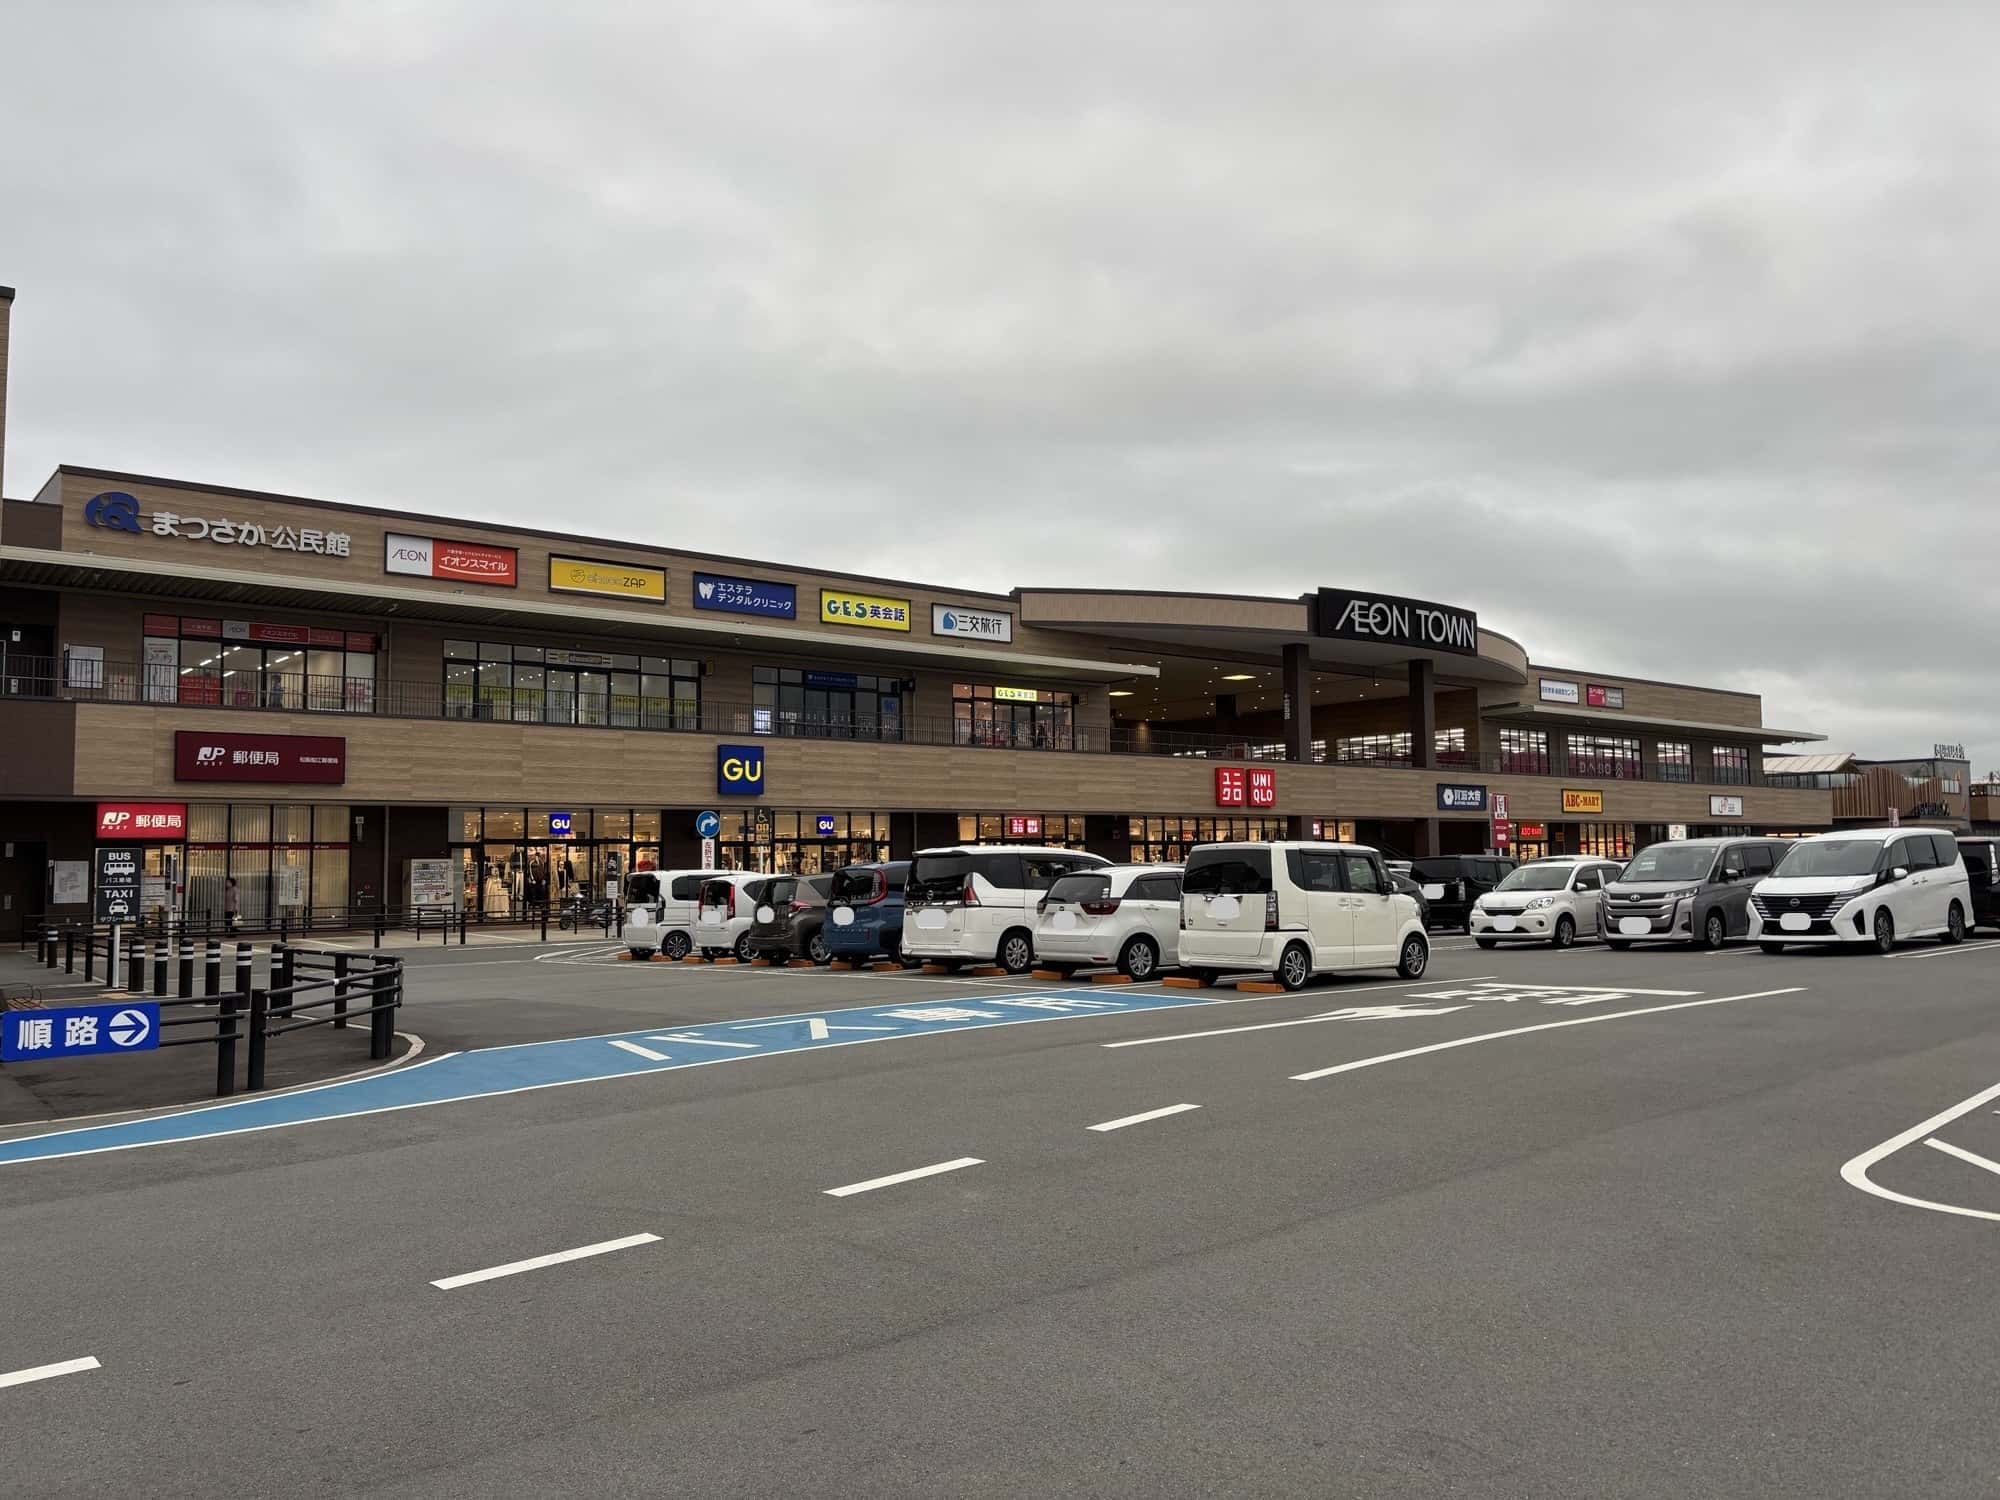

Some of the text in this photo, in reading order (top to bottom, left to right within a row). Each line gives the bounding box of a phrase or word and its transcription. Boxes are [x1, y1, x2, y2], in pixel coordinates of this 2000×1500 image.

[152, 511, 351, 558] まつさか公民館
[441, 556, 507, 571] イオンスマイル
[717, 582, 753, 595] エステラ
[717, 593, 792, 611] デンタルクリニック
[869, 604, 906, 622] 英会話
[958, 614, 1002, 635] 三交旅行
[1415, 609, 1475, 649] TOWN
[232, 750, 279, 766] 郵便局
[722, 757, 761, 782] GU
[1565, 794, 1600, 807] ABC-MART
[102, 811, 130, 825] JP
[135, 814, 182, 828] 郵便局
[552, 819, 570, 829] GU
[819, 820, 833, 830] GU
[108, 852, 131, 861] BUS
[104, 889, 133, 899] TAXI
[17, 1015, 99, 1051] 順路
[607, 996, 1128, 1061] バス専用
